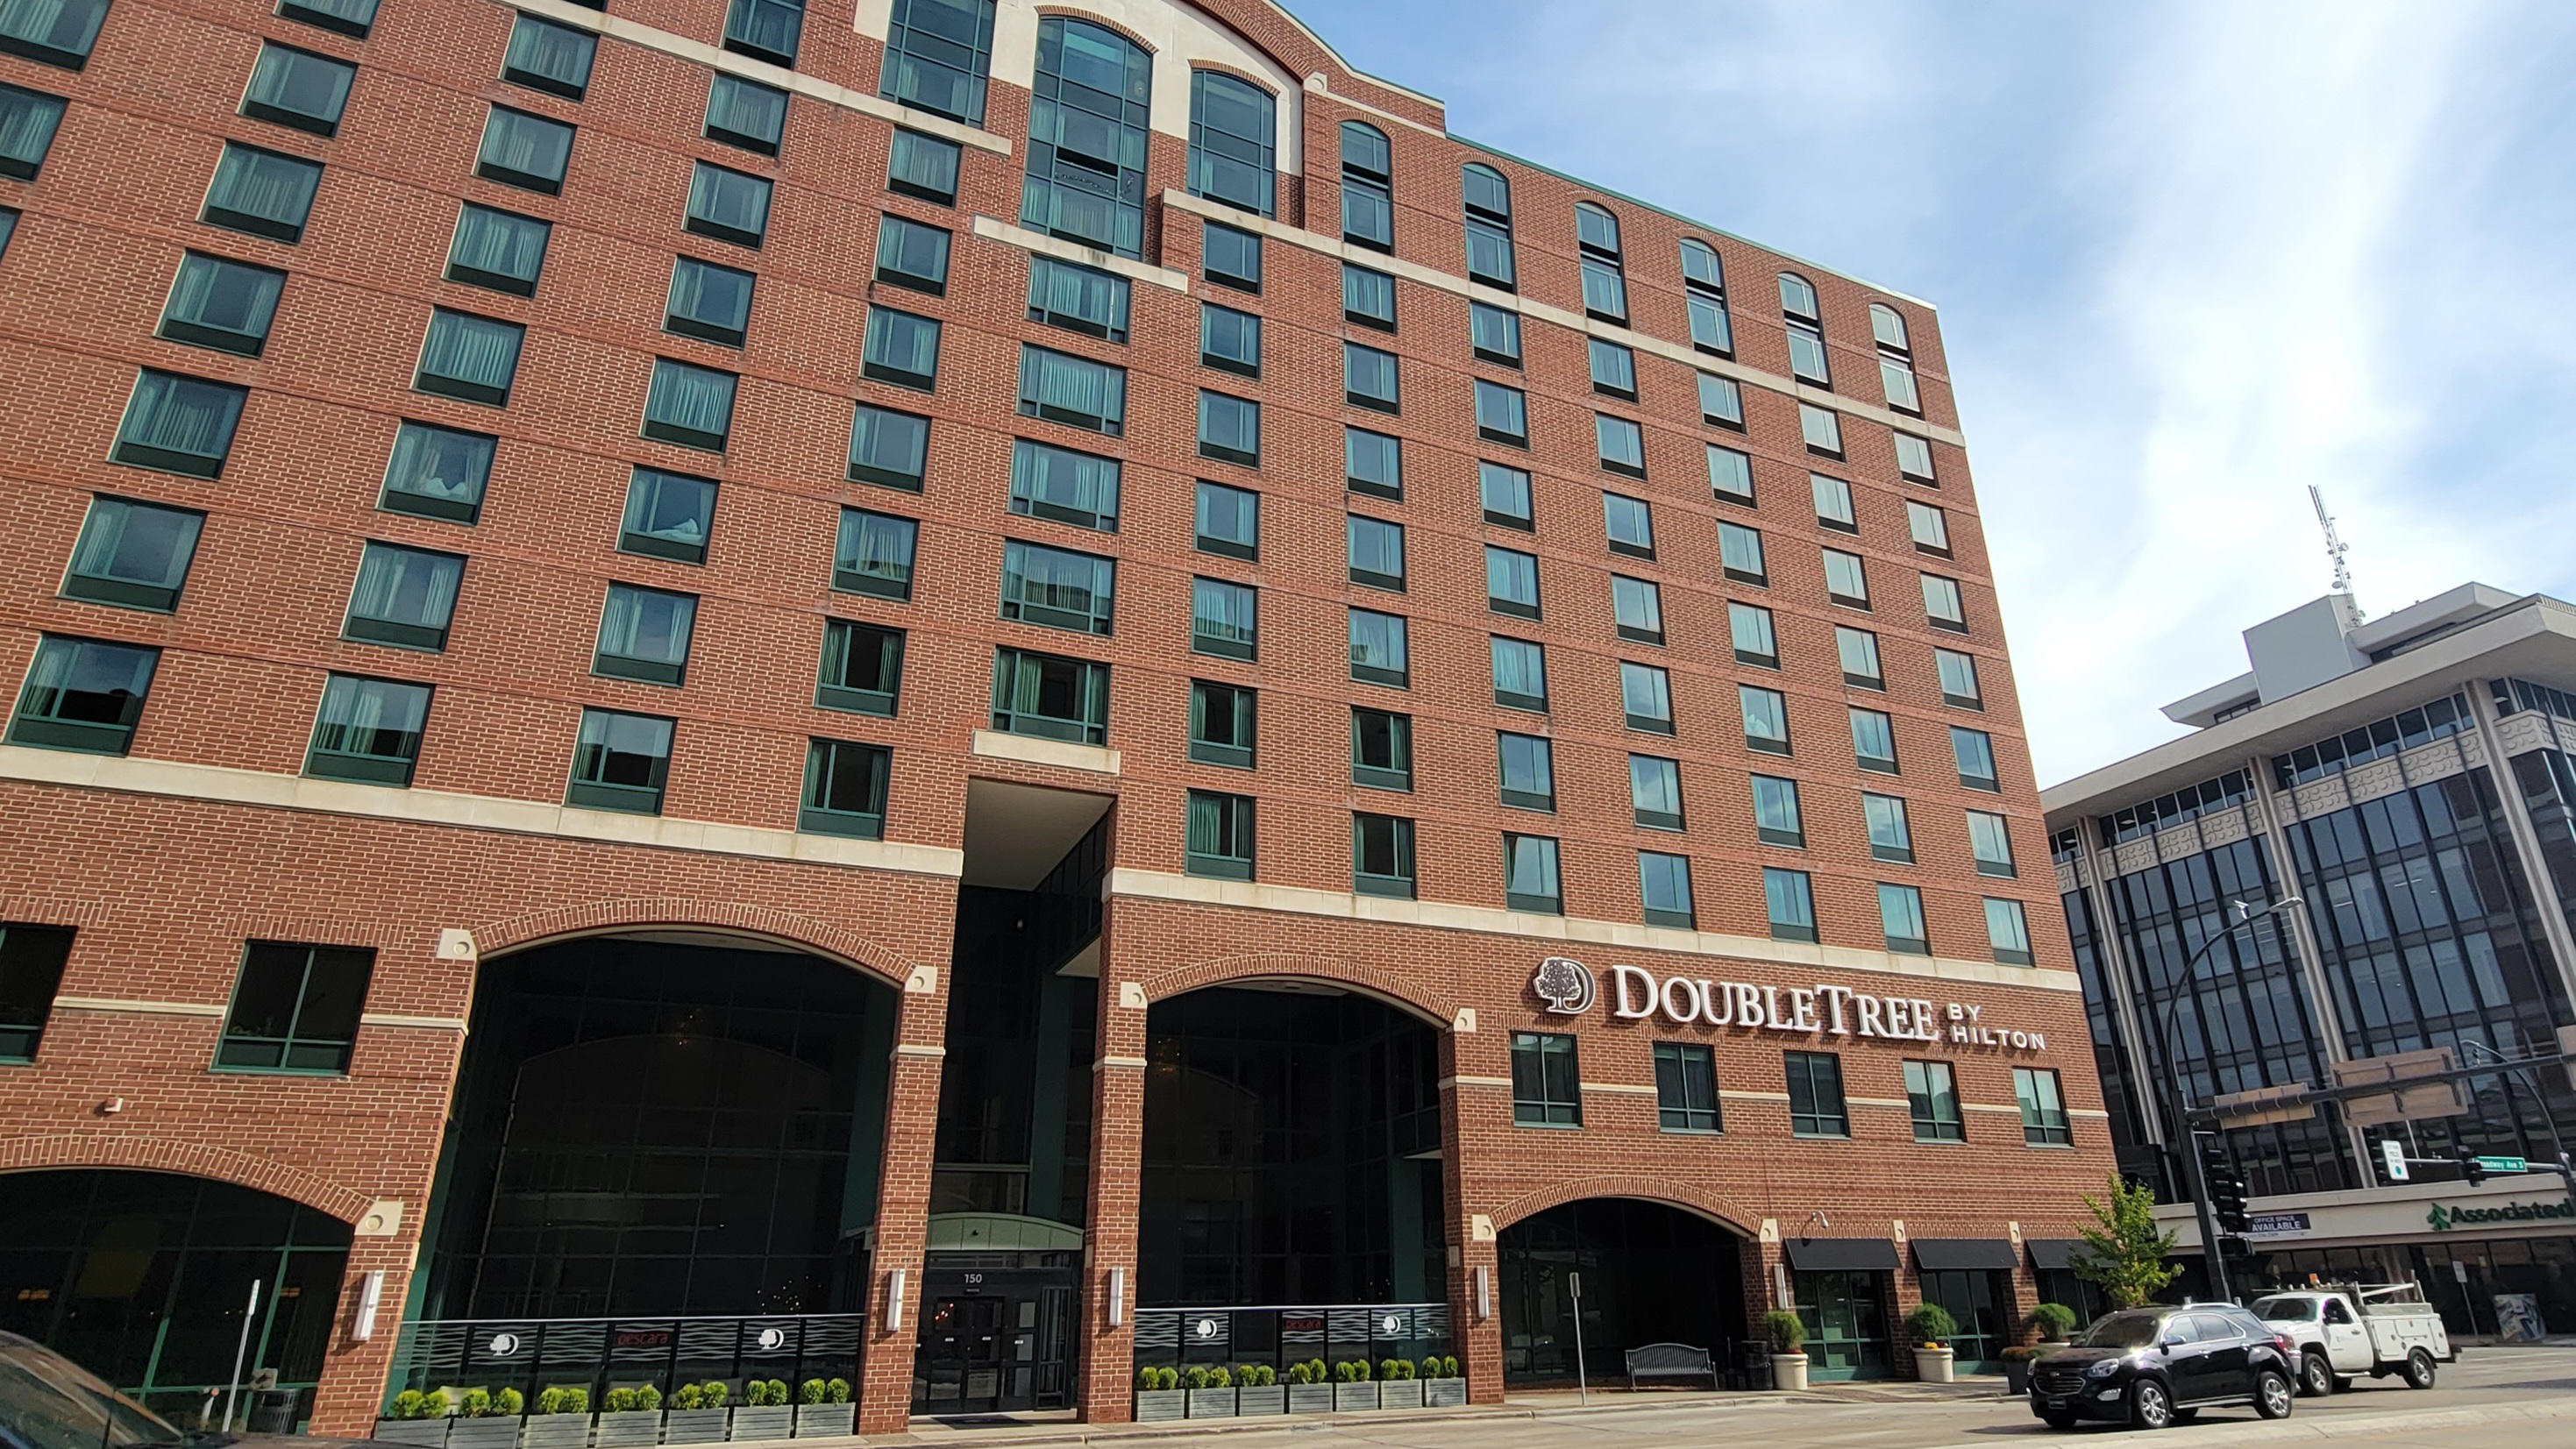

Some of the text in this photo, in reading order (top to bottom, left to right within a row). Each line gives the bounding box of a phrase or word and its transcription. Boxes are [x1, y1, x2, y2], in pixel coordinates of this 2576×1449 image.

[1946, 1003, 1981, 1022] BY
[1950, 1025, 2046, 1050] HILTON
[2451, 1197, 2575, 1224] Associated
[2252, 1221, 2302, 1232] AVAILABLE
[964, 1274, 982, 1283] 150
[617, 1333, 668, 1346] pescara
